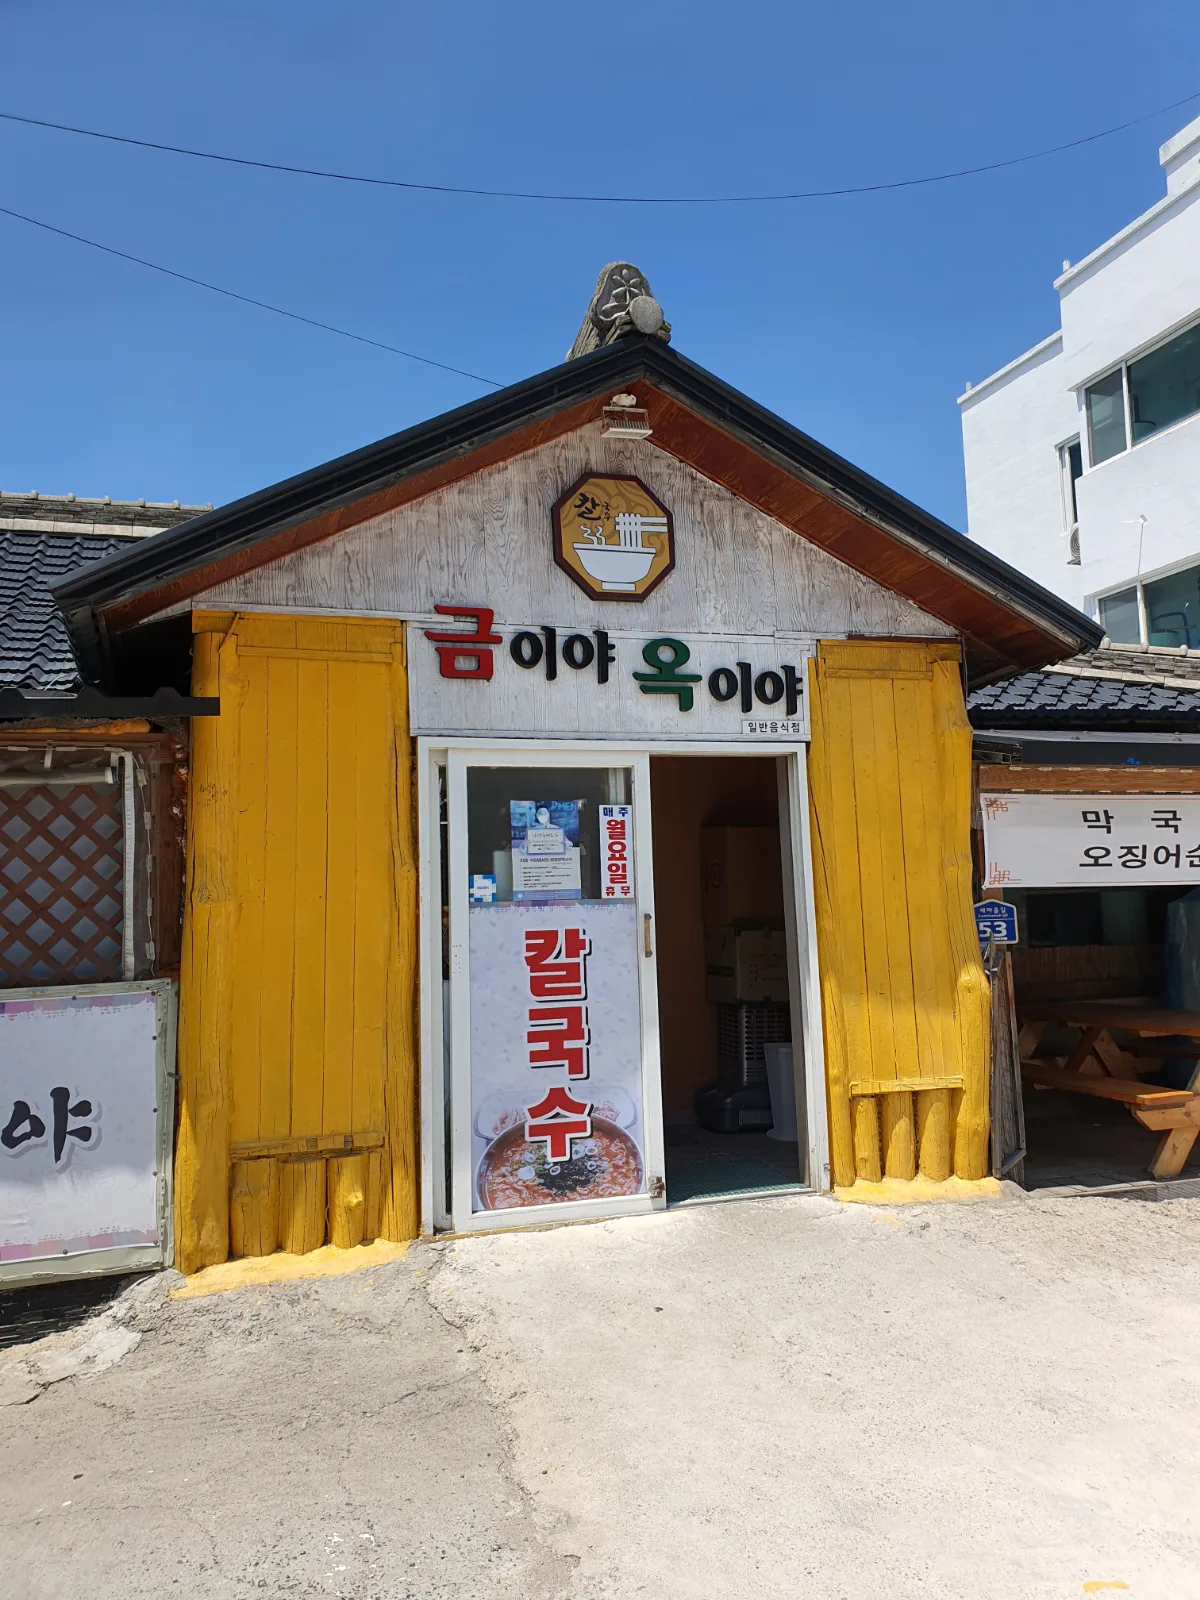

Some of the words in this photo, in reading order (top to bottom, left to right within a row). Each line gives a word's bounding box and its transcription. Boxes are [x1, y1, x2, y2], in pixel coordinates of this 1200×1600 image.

[424, 604, 616, 685] 금이야
[632, 637, 803, 716] 옥이야
[748, 721, 800, 733] 일반음식점
[603, 807, 628, 817] 매주
[606, 819, 627, 884] 월요일
[979, 921, 1007, 938] 53
[524, 928, 592, 1161] 칼국수
[0, 1086, 93, 1164] 야
